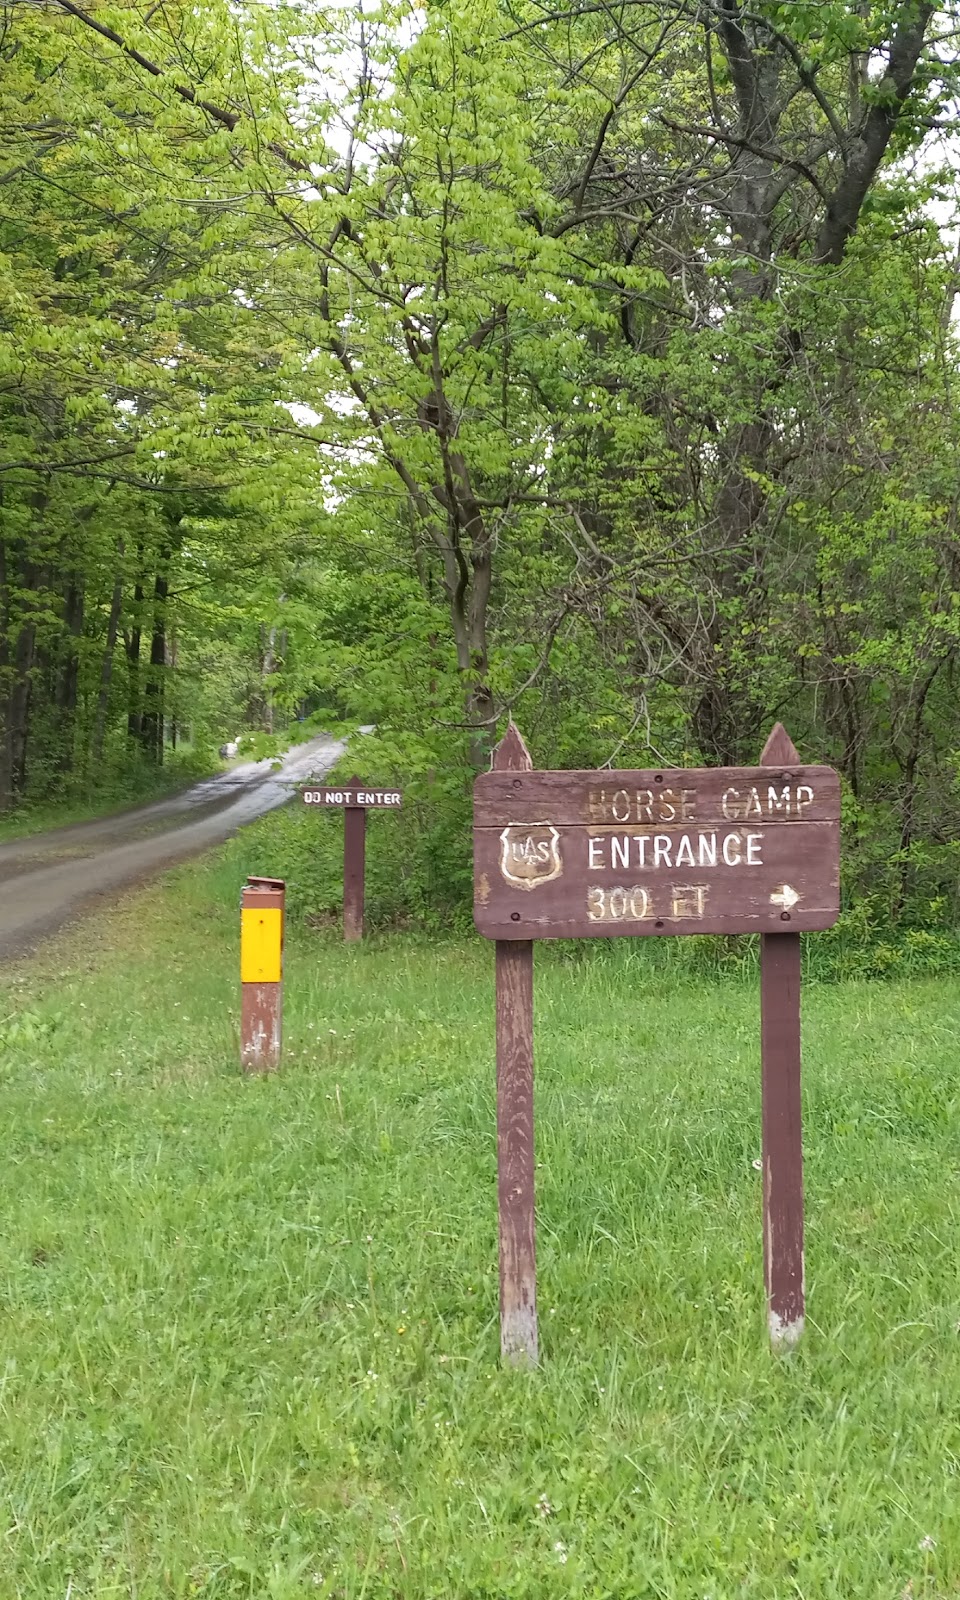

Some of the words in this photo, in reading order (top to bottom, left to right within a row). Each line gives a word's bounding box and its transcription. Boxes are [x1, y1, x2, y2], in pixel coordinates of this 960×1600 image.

[304, 791, 321, 804] DO
[325, 792, 352, 804] NOT
[356, 792, 401, 805] ENTER
[588, 788, 697, 822] HORSE
[721, 785, 815, 820] CAMP
[587, 833, 765, 869] ENTRANCE
[586, 886, 649, 921] 300
[672, 883, 710, 918] FT
